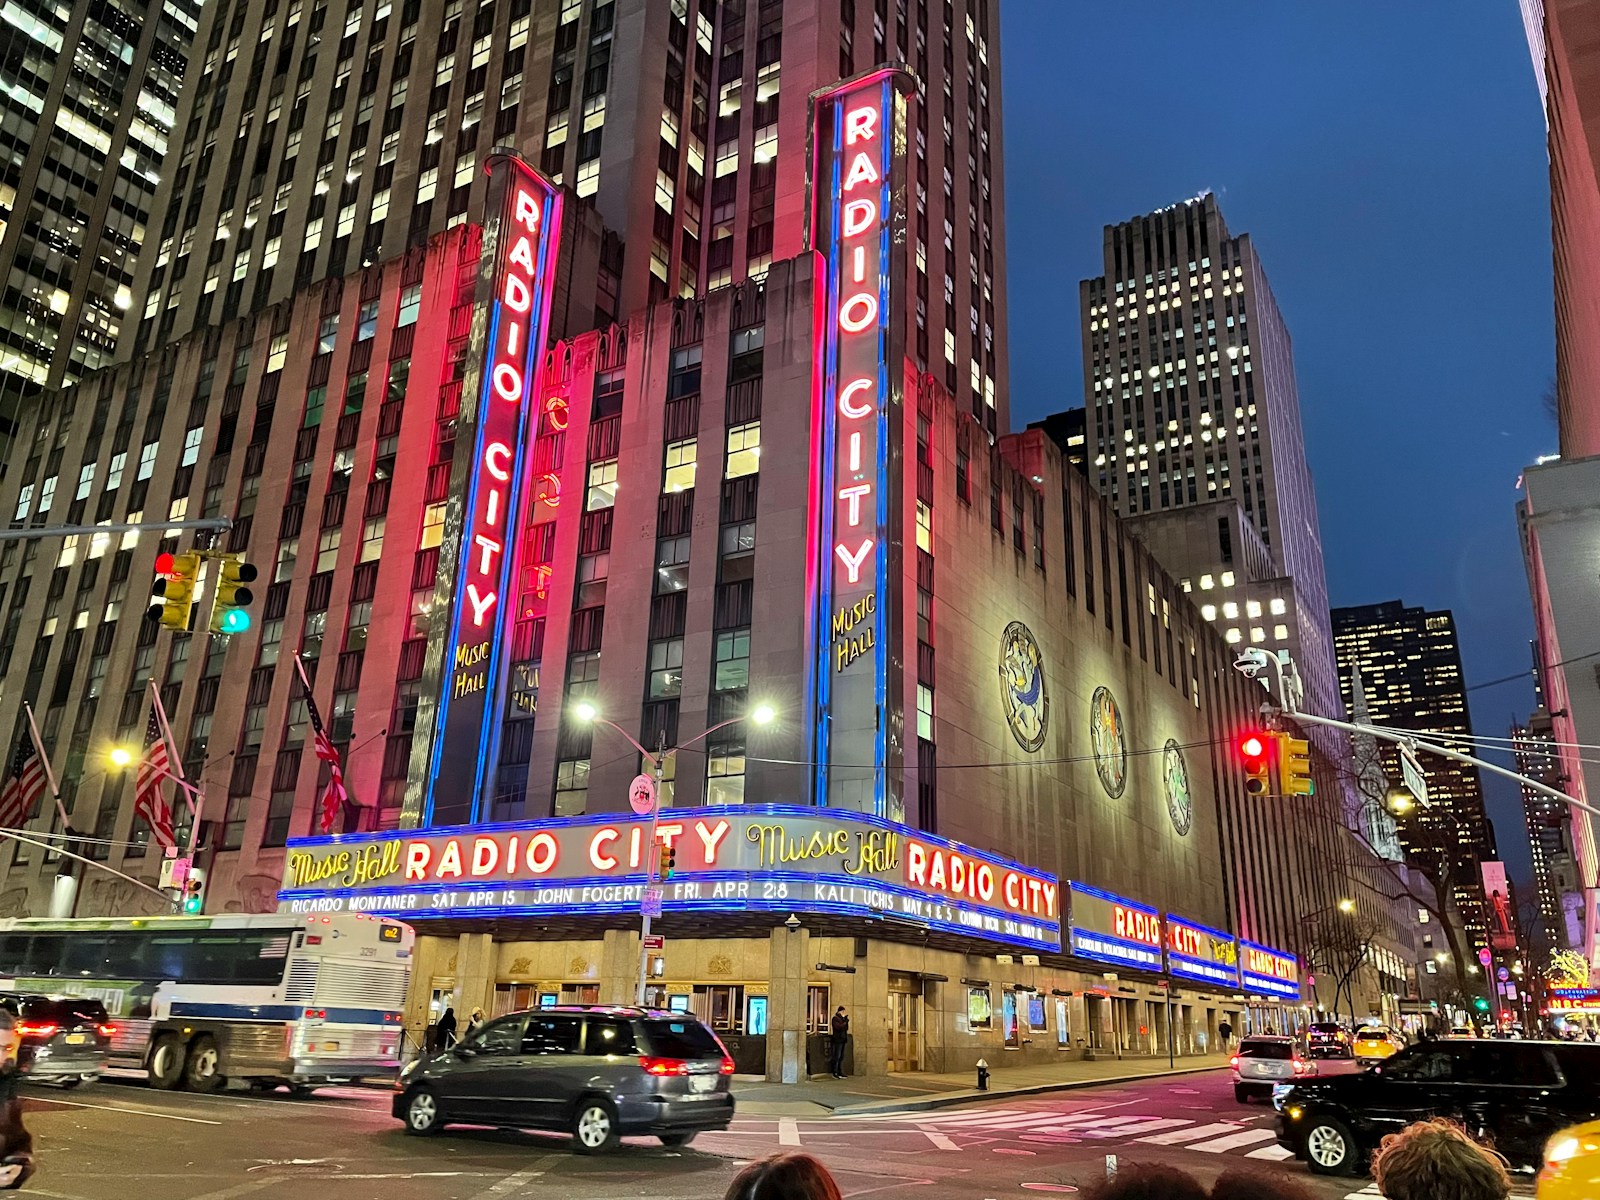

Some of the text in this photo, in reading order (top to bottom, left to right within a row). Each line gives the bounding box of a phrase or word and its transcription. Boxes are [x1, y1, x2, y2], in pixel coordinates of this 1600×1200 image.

[834, 106, 879, 583] RADIO CITY
[466, 189, 540, 626] RADIO CITY
[290, 819, 899, 887] Music Hall RADIO CITY Music Hall
[291, 896, 343, 912] RICARDO
[349, 894, 416, 911] MONTANER
[431, 893, 459, 908] SAT.
[467, 891, 494, 907] APR
[502, 890, 515, 905] 15
[534, 887, 573, 904] JOHN
[581, 884, 650, 902] FOGERT
[675, 882, 703, 899] FRI.
[713, 881, 749, 899] APR
[763, 882, 789, 899] 28
[815, 884, 854, 903] KALI
[863, 889, 894, 910] UCHIS
[907, 842, 1056, 917] RADIO CITY
[1115, 906, 1160, 945] RADIO
[1175, 925, 1201, 956] CITY
[1249, 949, 1274, 976] RADIO
[1275, 957, 1292, 979] CITY
[1552, 999, 1582, 1009] NBC
